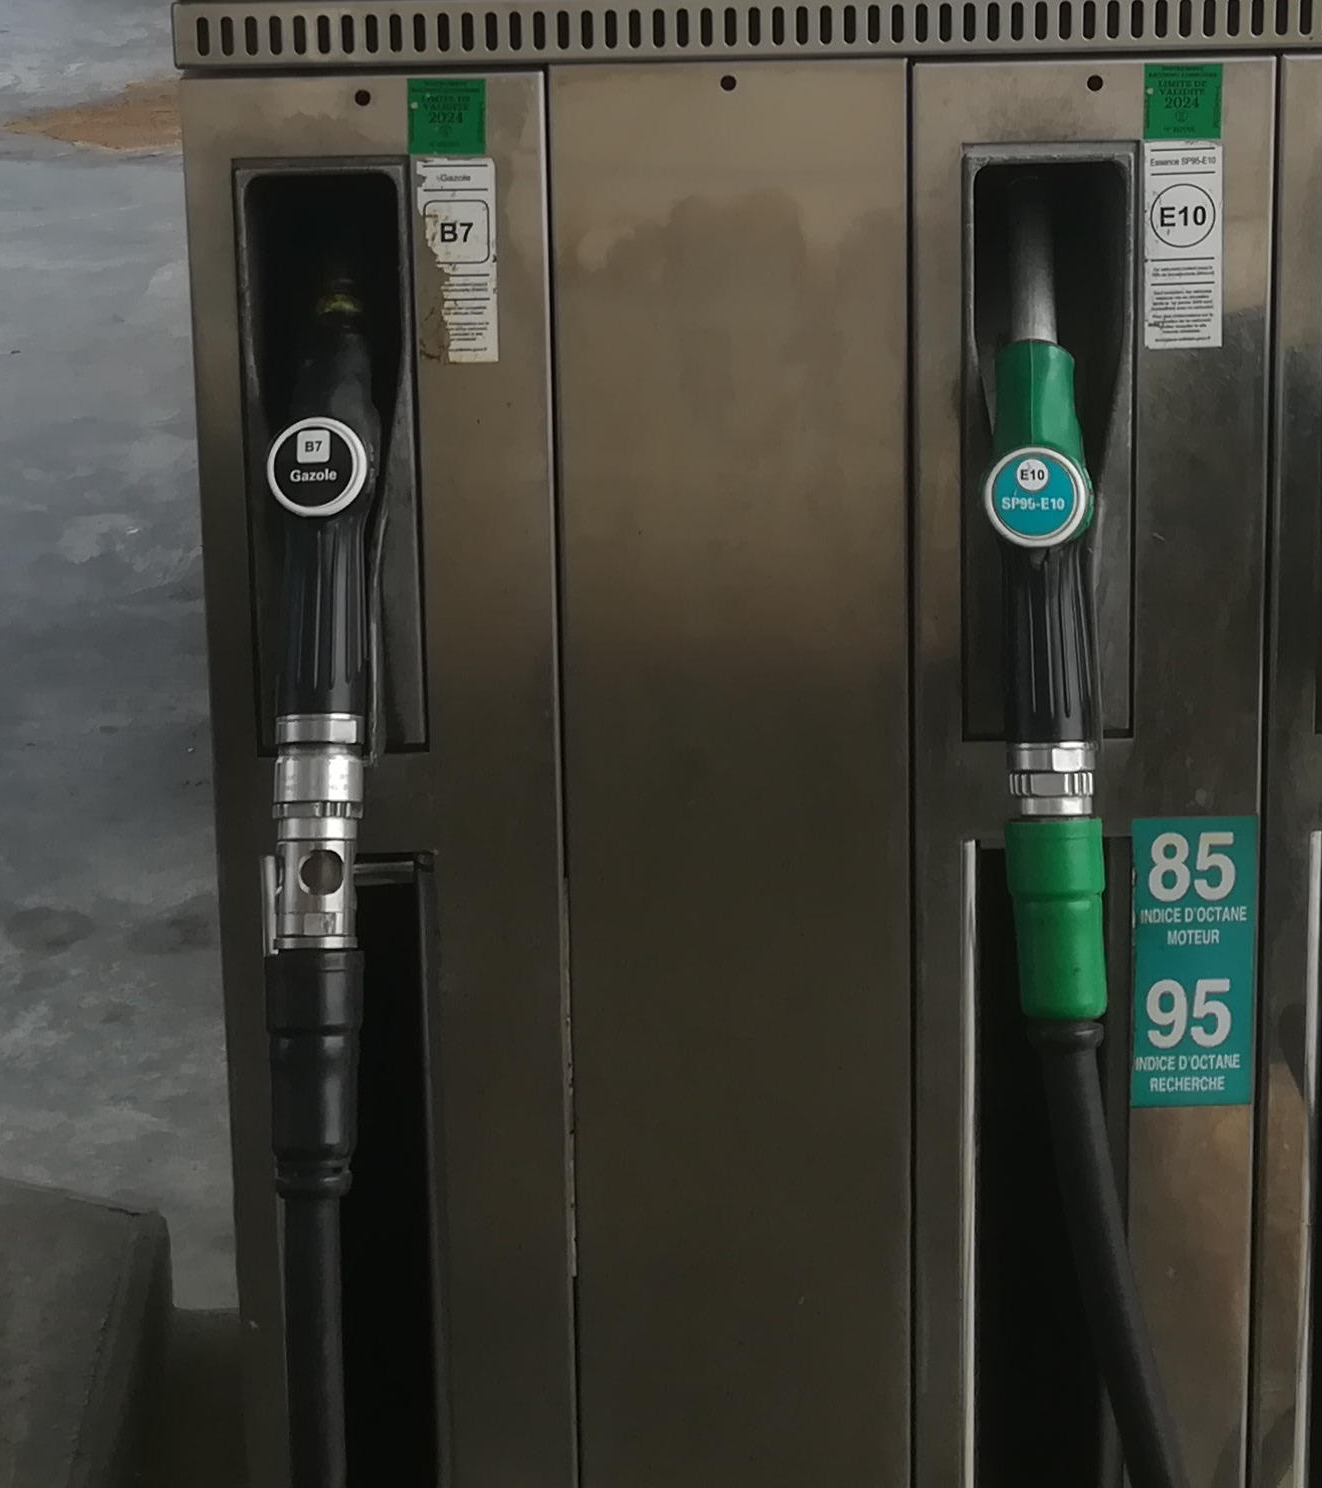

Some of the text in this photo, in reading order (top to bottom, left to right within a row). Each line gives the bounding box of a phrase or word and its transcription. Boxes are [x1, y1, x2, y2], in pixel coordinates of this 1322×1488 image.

[1164, 96, 1200, 109] 2024
[428, 111, 463, 124] 2024
[440, 173, 472, 182] Gazole
[1160, 205, 1207, 227] E10
[440, 222, 474, 243] B7
[304, 440, 323, 453] B7
[289, 468, 338, 483] Gazole
[1020, 469, 1045, 481] E10
[1001, 497, 1066, 511] SP95-E10
[1148, 831, 1237, 903] 85
[1140, 906, 1248, 925] INDICE D'OCTANE
[1166, 929, 1221, 946] MOTEUR
[1146, 978, 1233, 1050] 95
[1135, 1053, 1241, 1072] INDICE D'OCTANE
[1149, 1075, 1226, 1093] RECHERCHE
